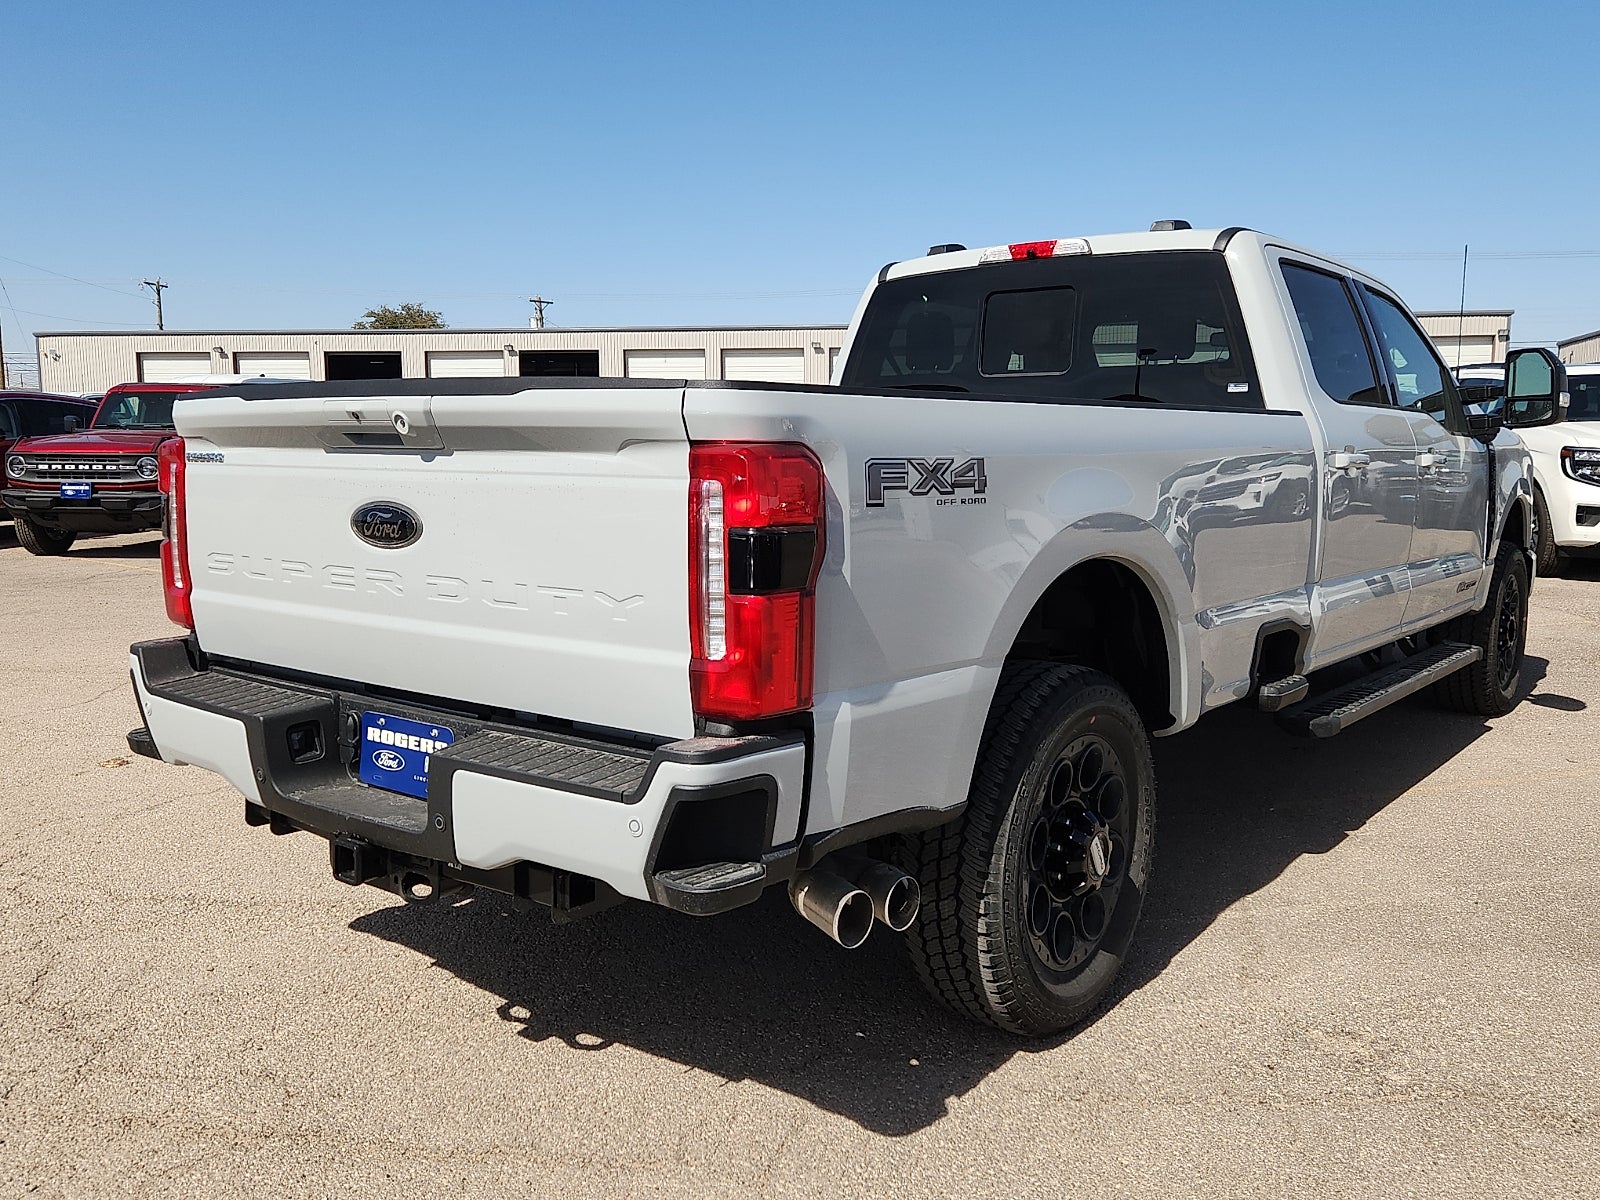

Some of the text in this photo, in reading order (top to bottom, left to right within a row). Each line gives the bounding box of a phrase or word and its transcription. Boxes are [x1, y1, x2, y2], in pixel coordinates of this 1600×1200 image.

[864, 457, 987, 507] FX4
[960, 497, 987, 505] ROAD
[363, 511, 402, 539] Ford
[207, 552, 645, 623] SUPER DUTY
[378, 751, 400, 769] Ford
